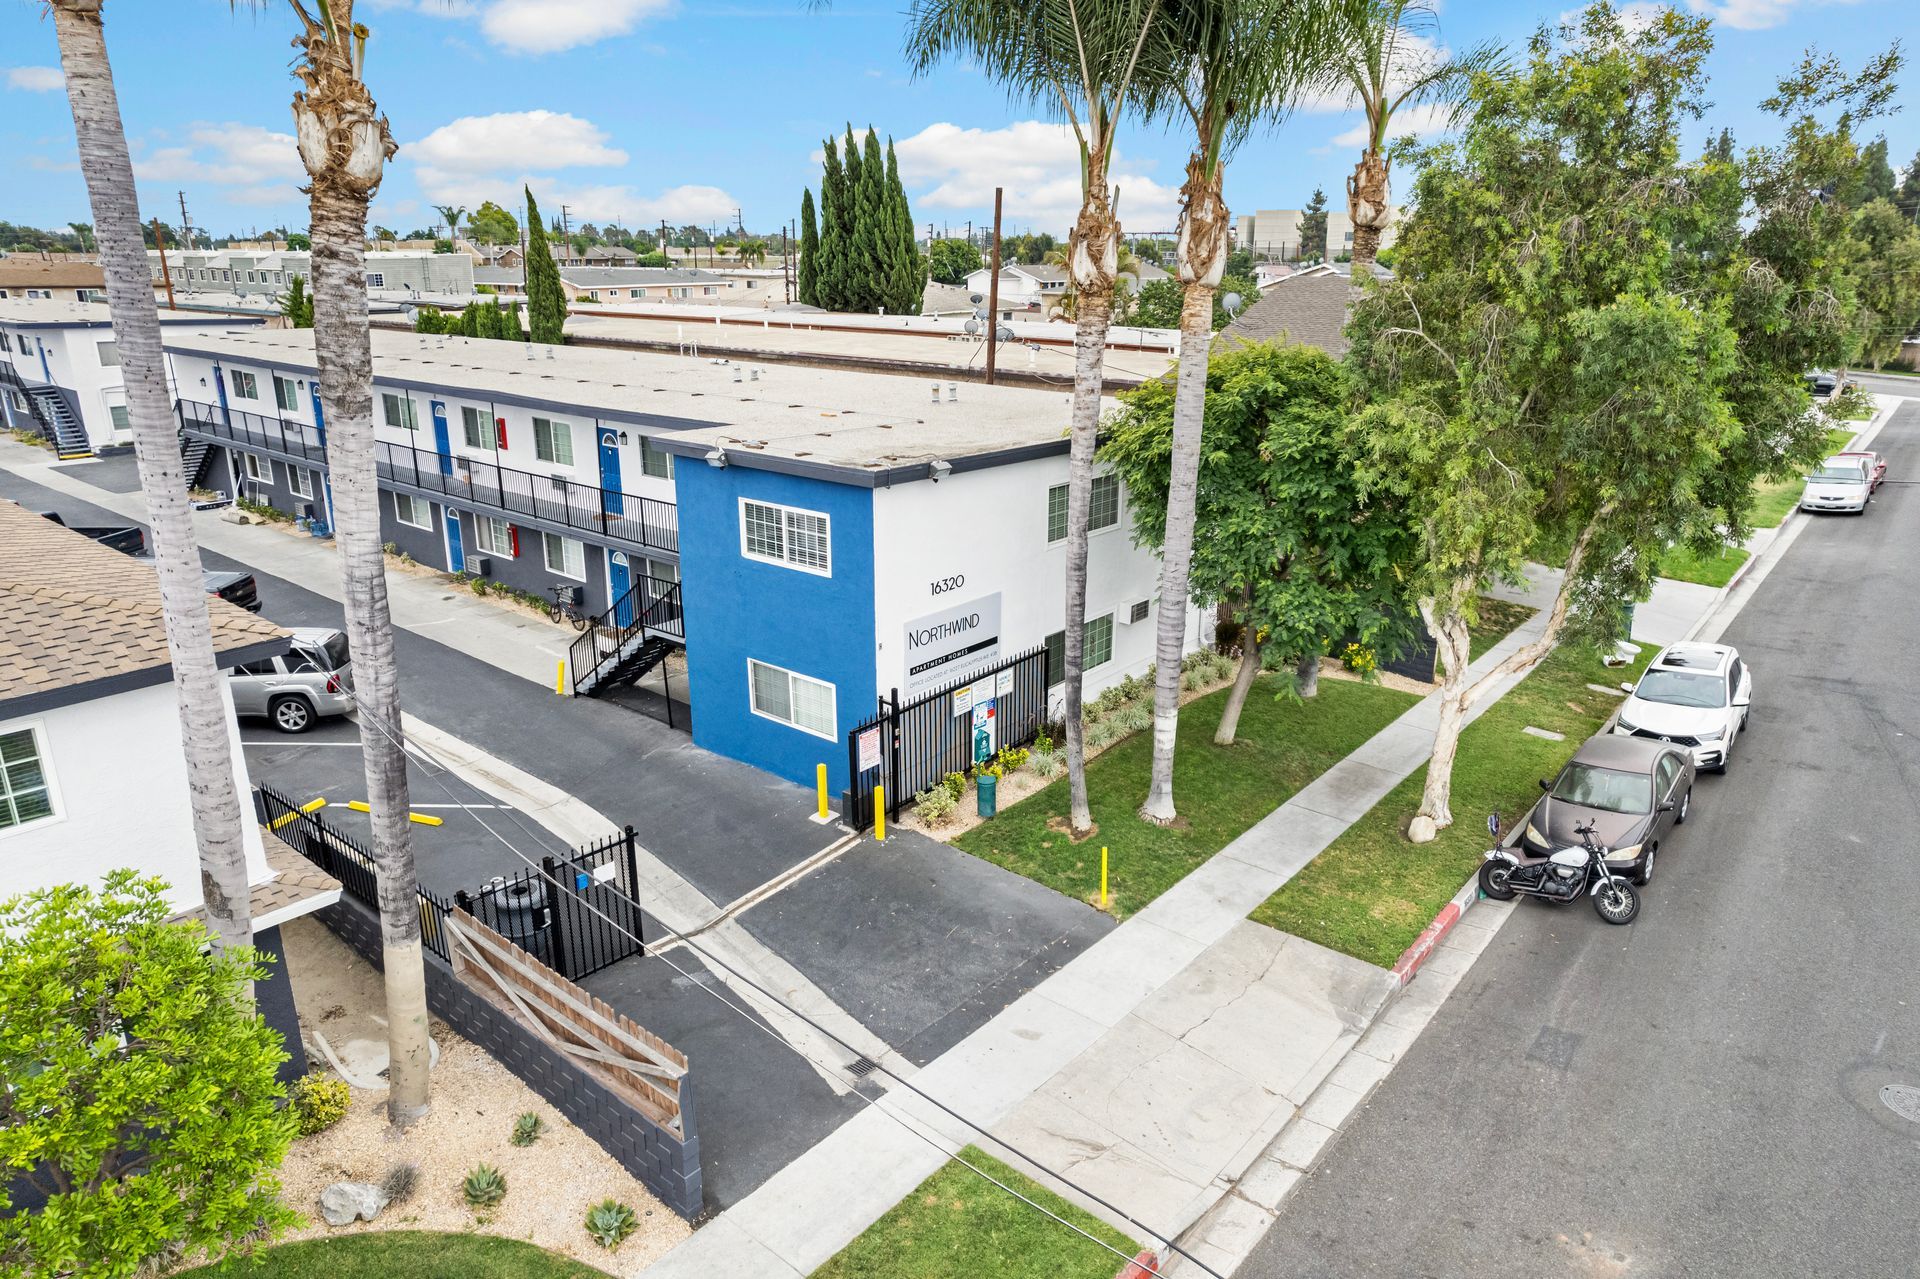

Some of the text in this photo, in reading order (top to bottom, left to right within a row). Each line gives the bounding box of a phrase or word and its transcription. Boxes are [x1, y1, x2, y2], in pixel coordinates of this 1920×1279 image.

[931, 574, 965, 596] 16320
[908, 613, 980, 650] NORTHWIND
[911, 648, 968, 674] APARTMENT HOMES
[910, 680, 924, 688] OFFICE
[925, 671, 943, 683] LOCATED
